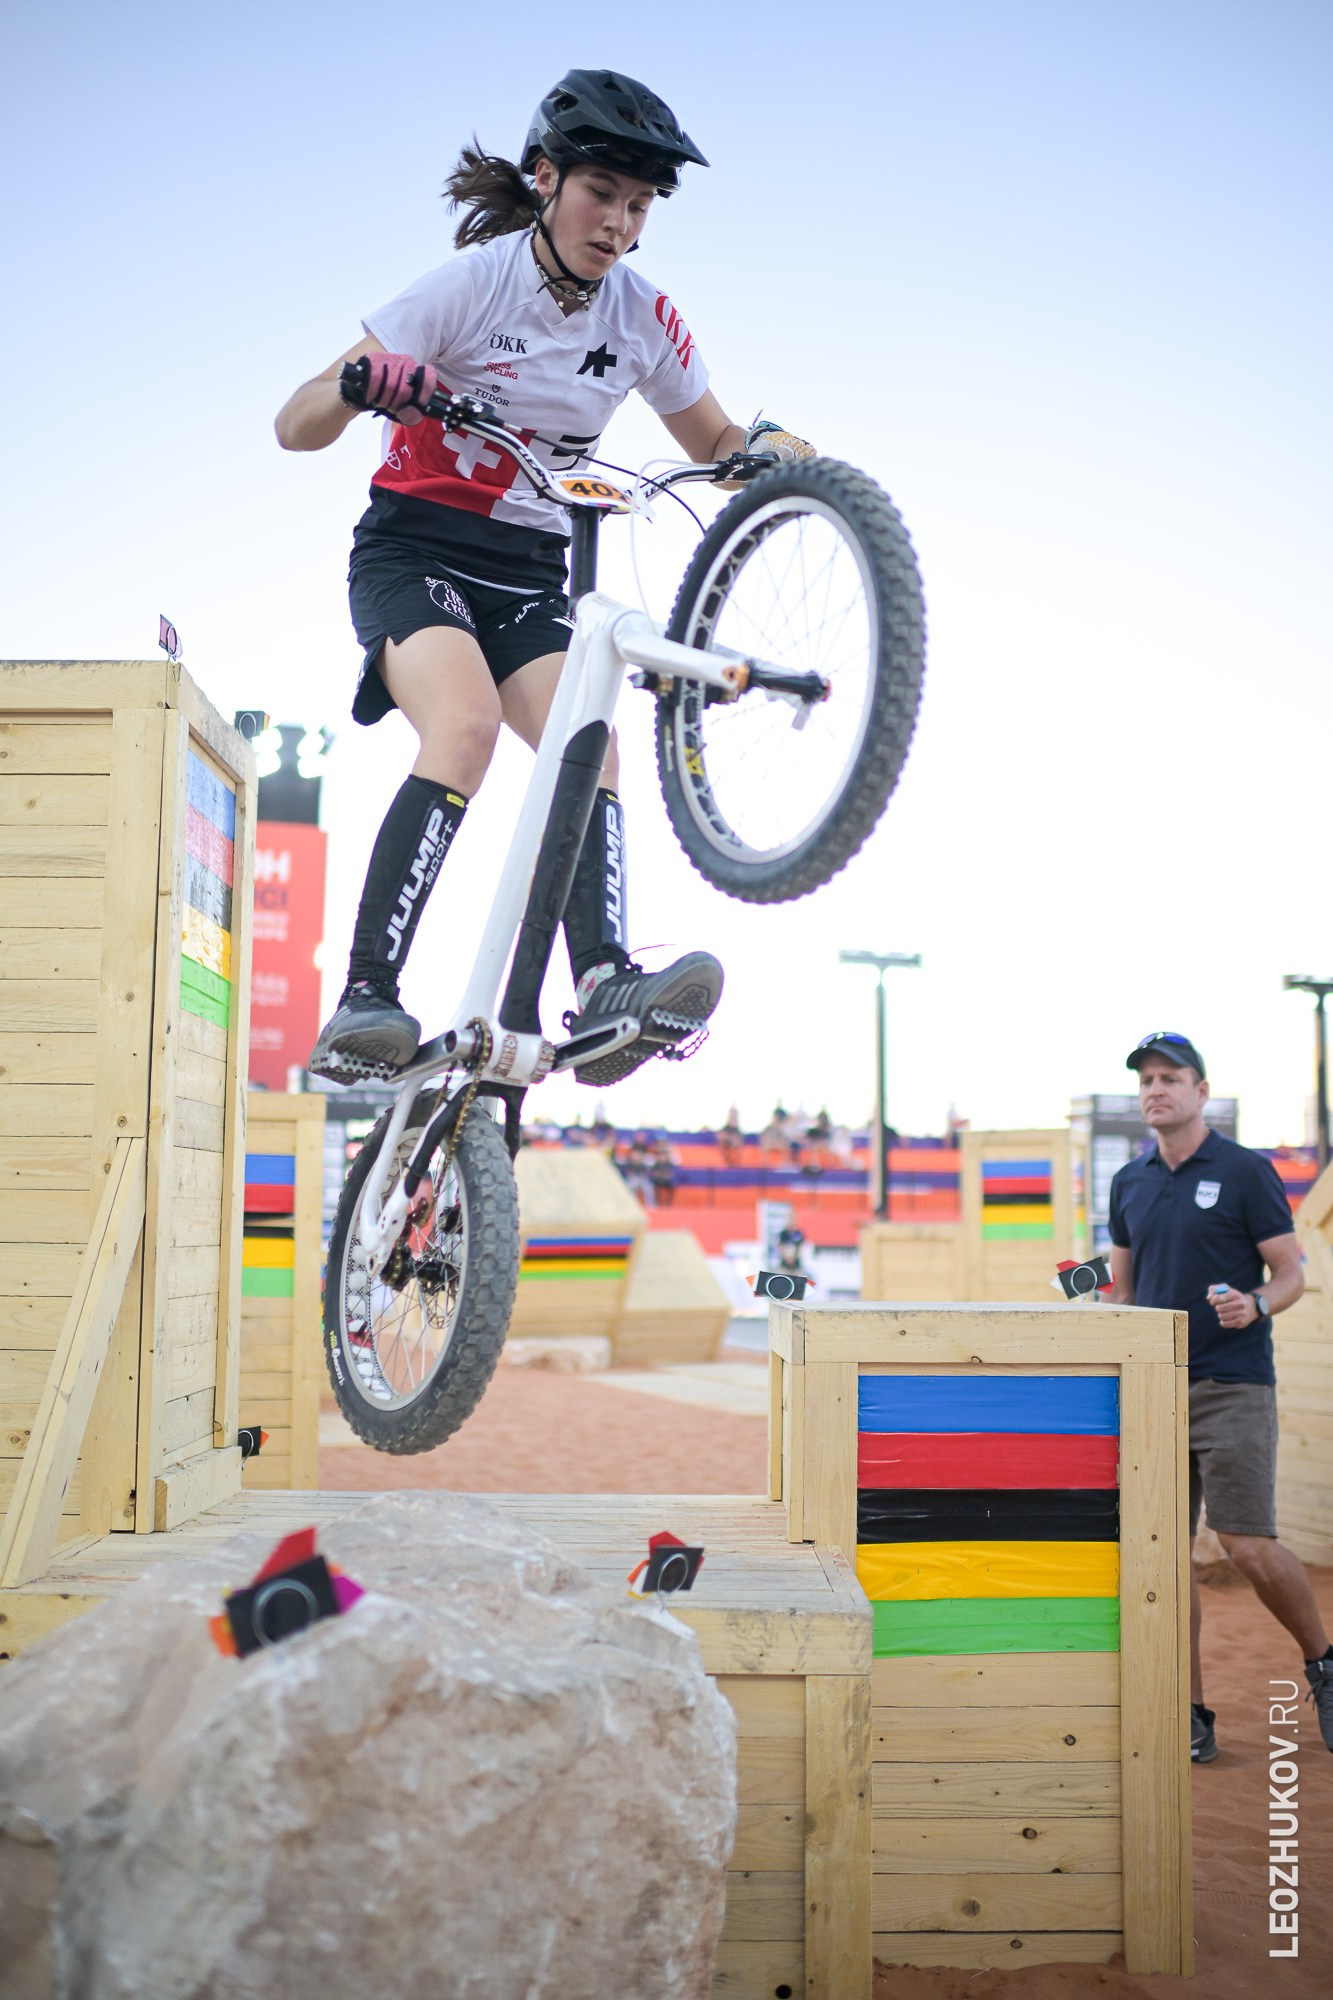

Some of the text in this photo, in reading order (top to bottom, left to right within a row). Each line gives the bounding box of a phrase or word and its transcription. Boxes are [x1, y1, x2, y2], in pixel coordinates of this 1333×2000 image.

[490, 333, 528, 354] ÖKK
[484, 365, 518, 380] CYCLING
[475, 387, 510, 407] TUDOR
[606, 804, 623, 944] JUUMP
[386, 808, 444, 962] JUUMP
